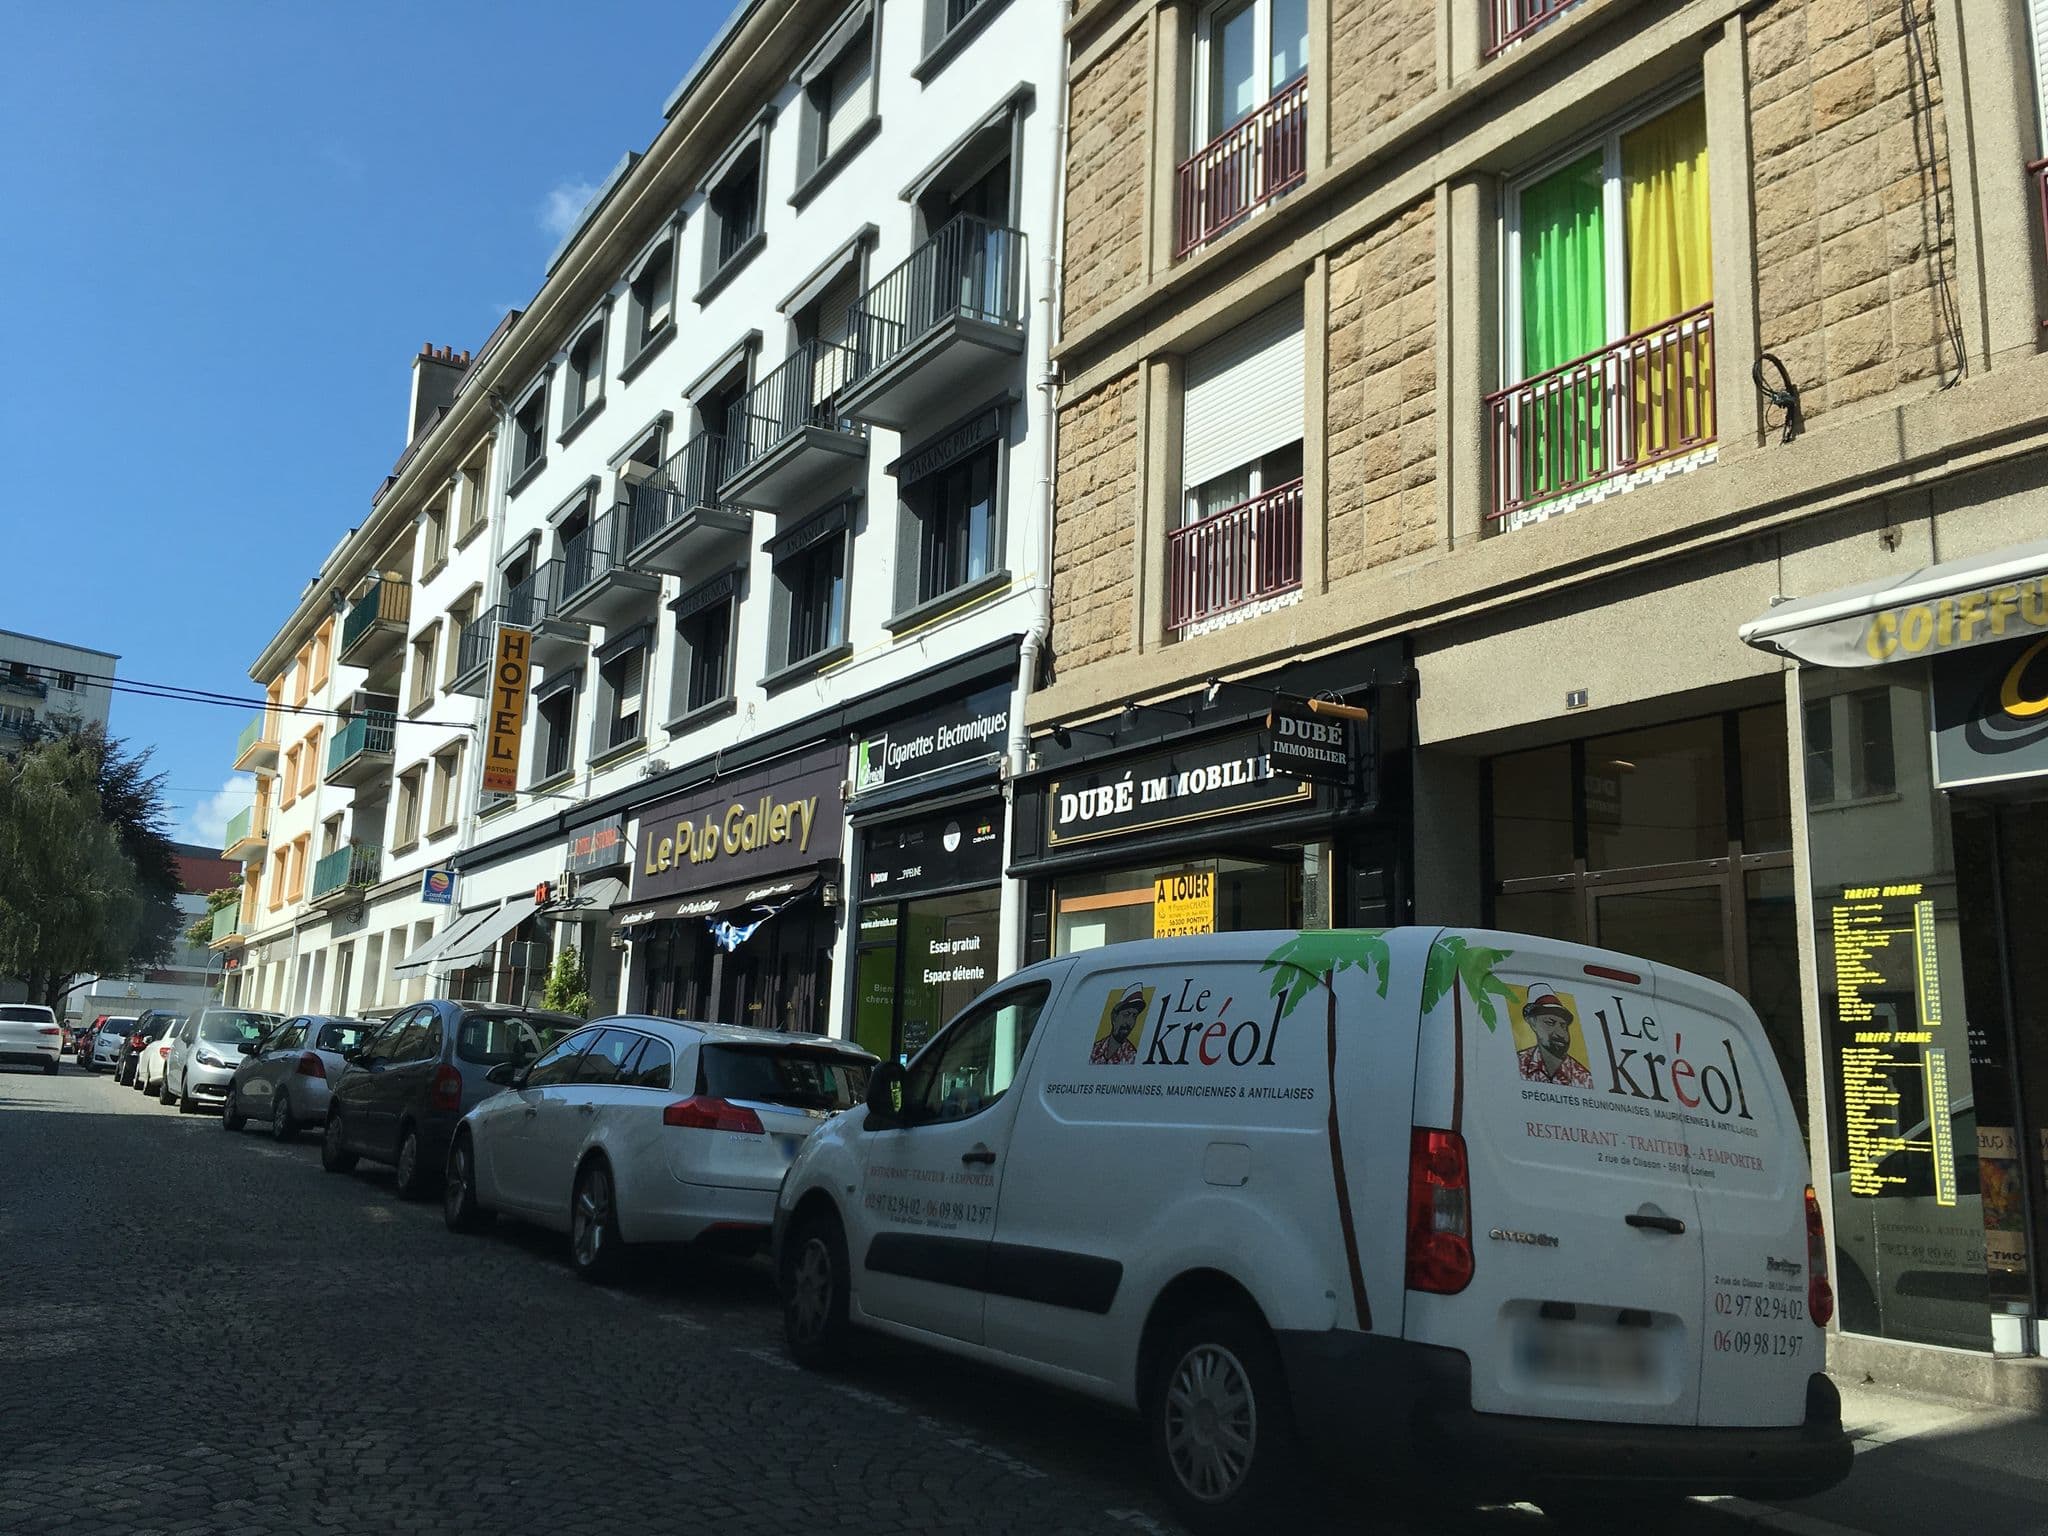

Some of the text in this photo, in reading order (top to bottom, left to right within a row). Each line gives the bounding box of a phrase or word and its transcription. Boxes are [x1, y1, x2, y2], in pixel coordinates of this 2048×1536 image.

[490, 634, 524, 761] HOTEL
[1573, 692, 1579, 706] 1
[888, 711, 1007, 769] Cigarettes Electroniques
[1279, 717, 1343, 746] DUBÉ
[1273, 741, 1347, 765] IMMOBILIER
[1059, 754, 1292, 824] DUBÉ IMMOBILIE
[645, 795, 819, 876] Le Pub Gallery
[1158, 874, 1209, 903] A LOUER
[1843, 884, 1924, 900] TARIFS HOMME
[930, 936, 980, 955] Essai gratuit
[923, 965, 984, 985] Espace détente
[1175, 978, 1211, 1013] Le
[1142, 988, 1289, 1067] kréol
[1611, 996, 1659, 1041] Le
[1854, 1032, 1933, 1044] TARIFS FEMME
[1595, 1009, 1753, 1120] kréol
[1166, 1085, 1236, 1098] MAURICIENNES
[1239, 1087, 1246, 1098] &
[1247, 1087, 1315, 1100] ANTILLAISES
[1521, 1090, 1580, 1106] SPÉCIALITÉS
[1654, 1109, 1710, 1128] MAURICIENNES
[1711, 1119, 1717, 1129] &
[1717, 1121, 1760, 1138] ANTILLAISES
[1526, 1122, 1618, 1147] RESTAURANT
[1628, 1135, 1692, 1158] TRAITEUR
[1706, 1148, 1765, 1172] EMPORTER
[1597, 1152, 1603, 1162] 2
[1605, 1155, 1618, 1164] rue
[1621, 1155, 1631, 1165] de
[1715, 1292, 1803, 1320] 02 97 82 94 02
[1714, 1330, 1803, 1357] 06 09 98 12 97
